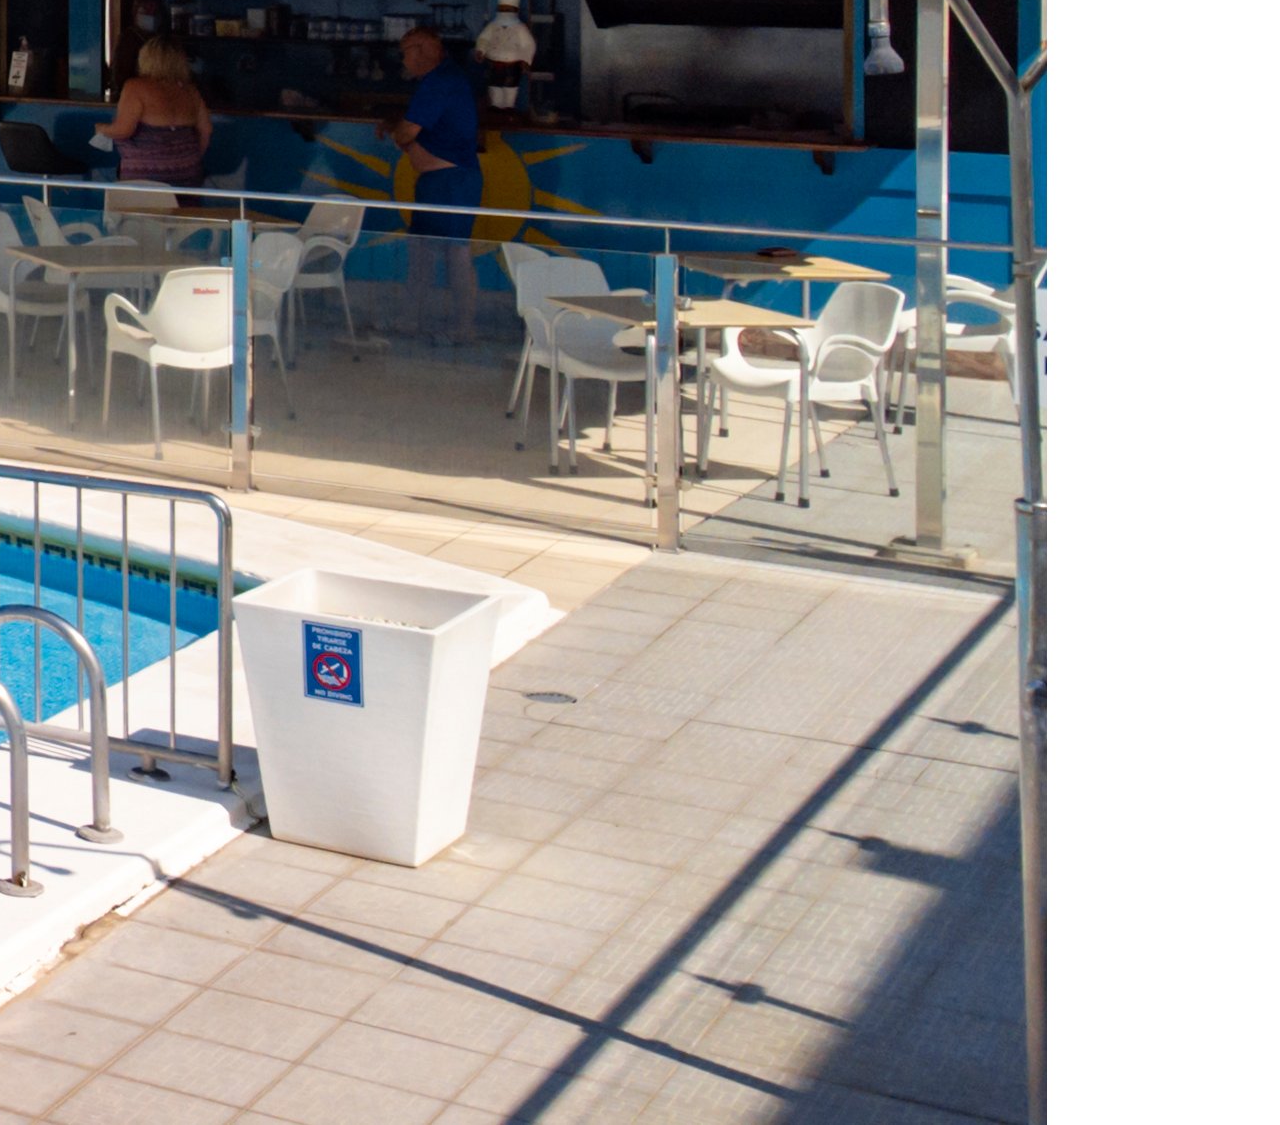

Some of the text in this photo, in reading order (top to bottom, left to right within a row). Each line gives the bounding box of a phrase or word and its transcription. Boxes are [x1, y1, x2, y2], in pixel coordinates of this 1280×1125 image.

[312, 626, 352, 639] PROHIBIDO
[317, 635, 347, 646] TIRARSE
[312, 642, 353, 654] DE CABEZA
[327, 691, 353, 701] DIVING
